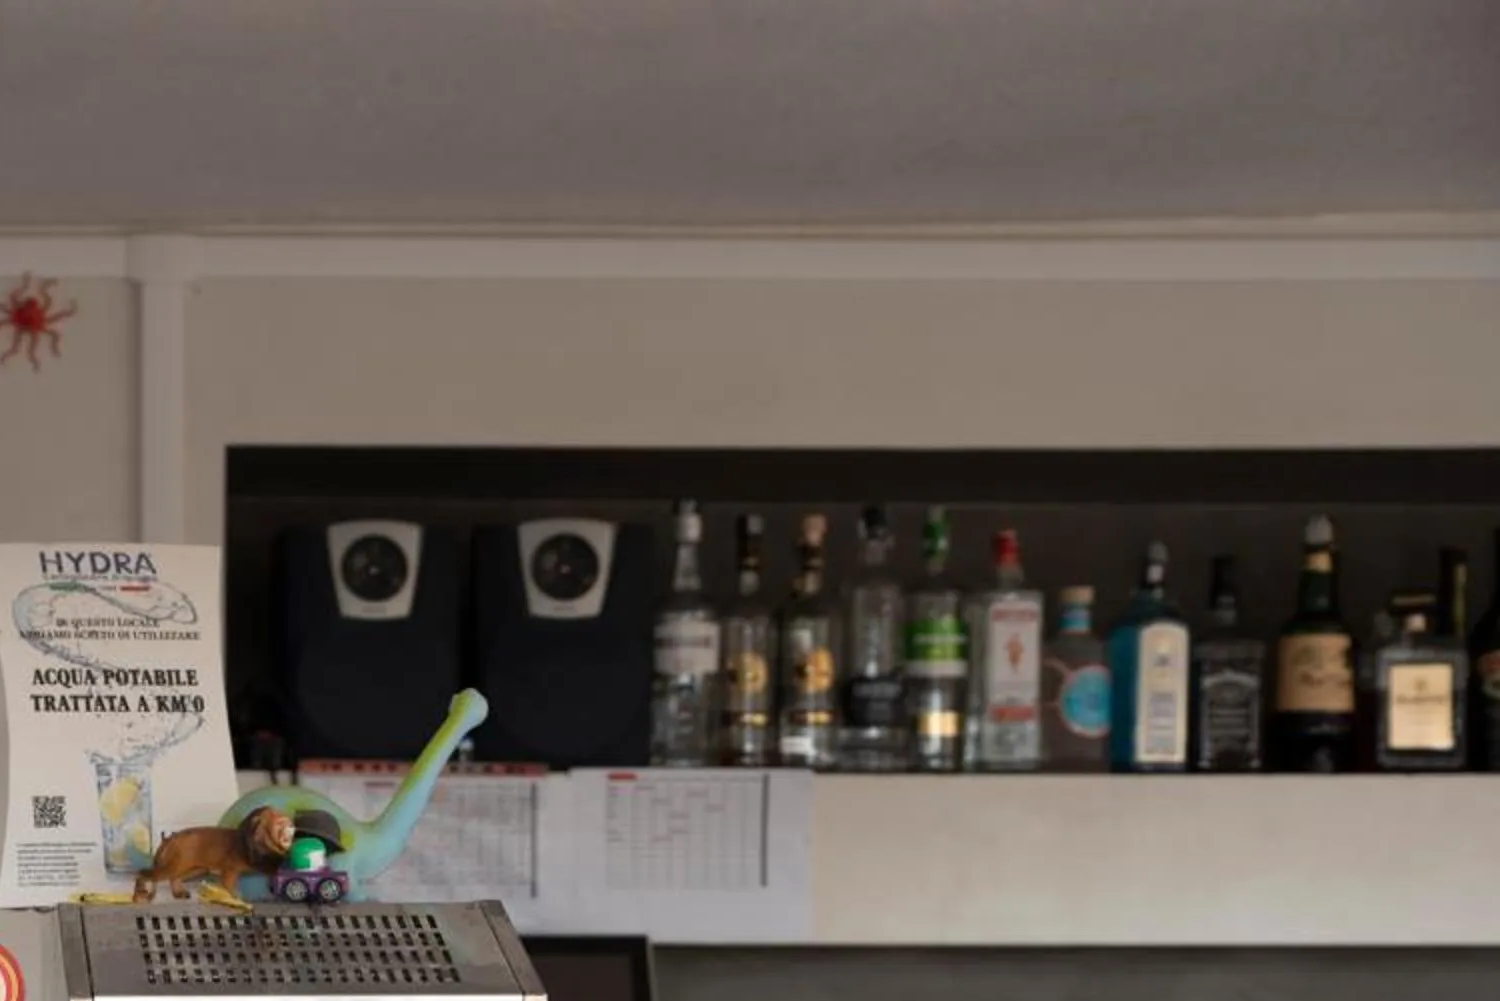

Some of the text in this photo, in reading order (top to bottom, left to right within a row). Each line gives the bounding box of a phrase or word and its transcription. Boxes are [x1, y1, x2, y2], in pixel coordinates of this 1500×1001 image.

[39, 551, 157, 574] HYDRA
[117, 617, 160, 628] LOCALE
[33, 668, 199, 688] ACQUA POTABILE
[30, 694, 130, 712] TRATTATA
[137, 695, 151, 712] A
